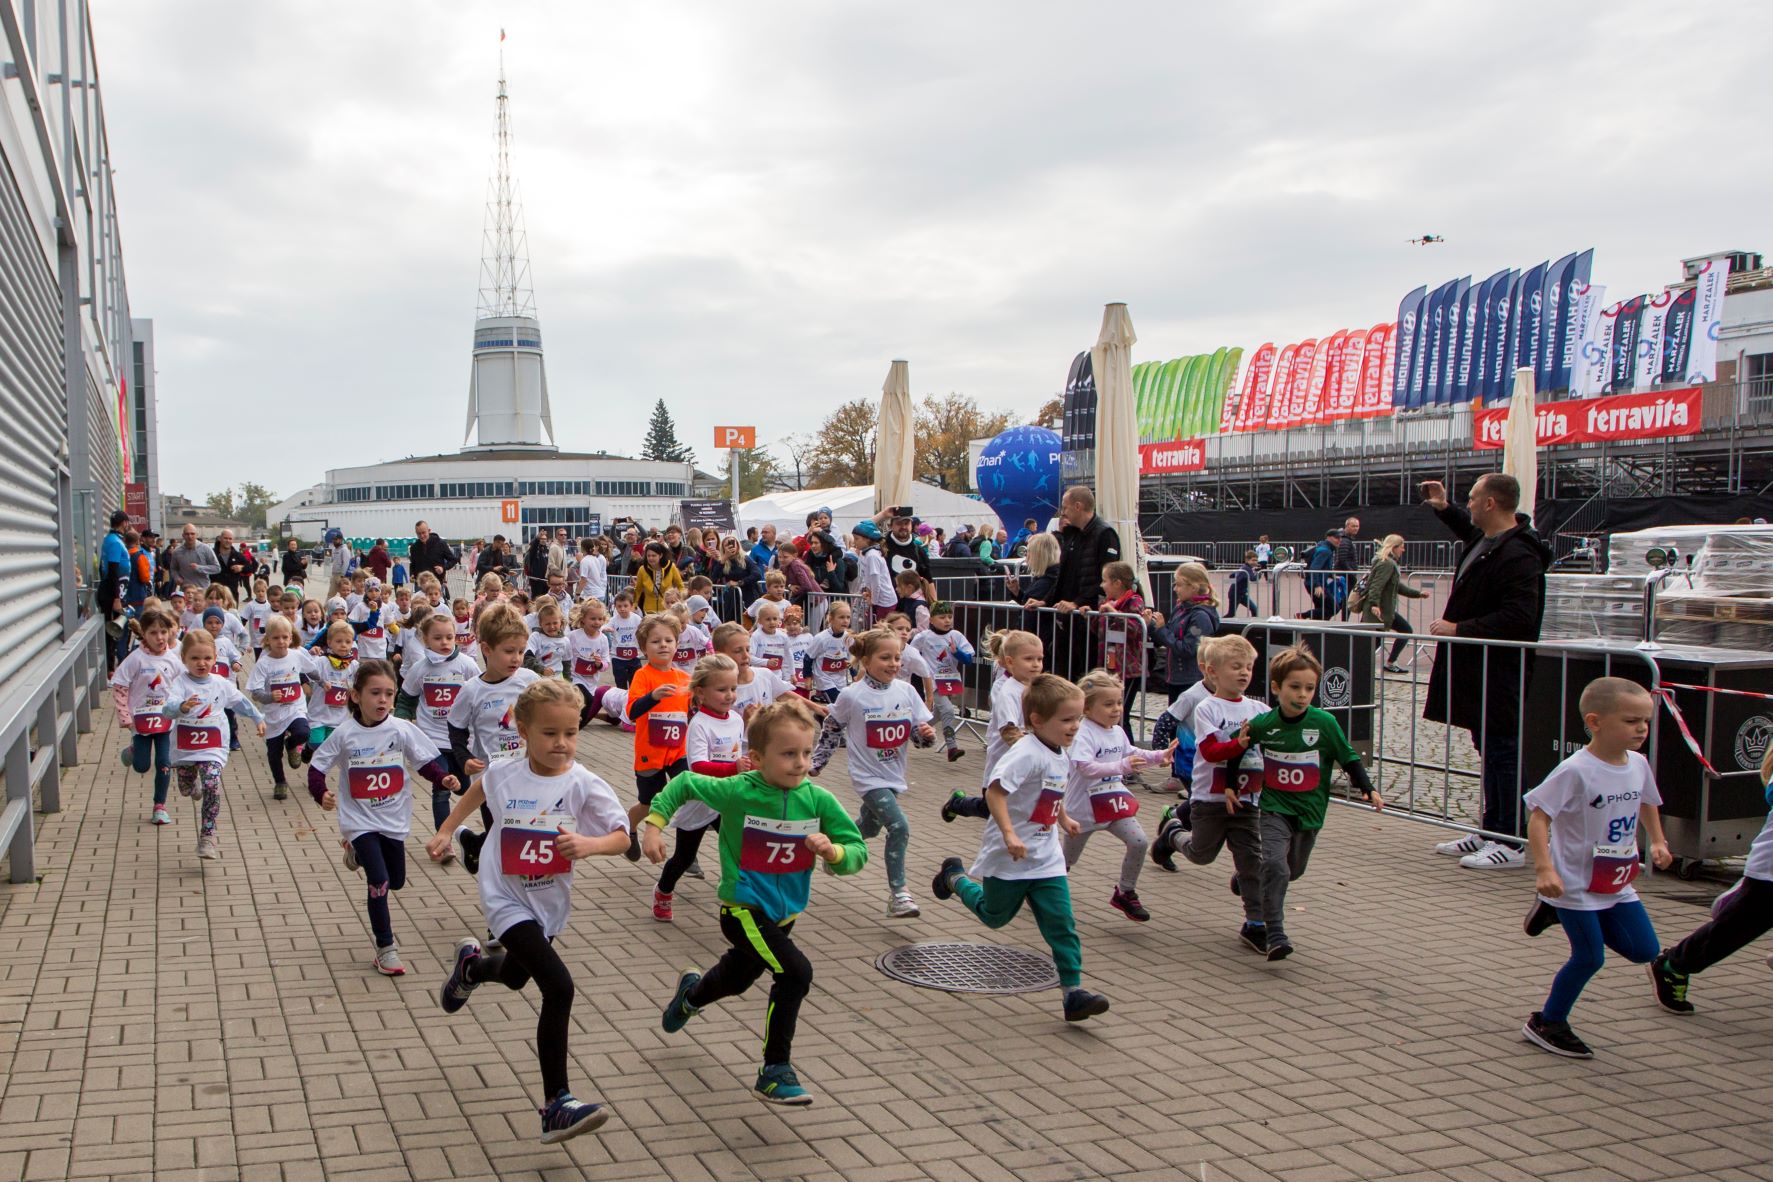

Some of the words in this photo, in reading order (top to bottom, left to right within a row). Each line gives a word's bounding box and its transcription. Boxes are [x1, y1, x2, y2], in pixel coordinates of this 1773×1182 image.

[1562, 306, 1578, 368] HYUNDAI
[1396, 336, 1413, 390] HYUNDAI
[1458, 328, 1474, 386] HYUNDAI
[1336, 337, 1364, 413] terravita
[1588, 398, 1688, 433] terravita
[1482, 410, 1568, 441] terita
[1152, 446, 1200, 468] terravita
[506, 504, 515, 518] 11
[282, 686, 295, 698] 74
[434, 688, 452, 702] 25
[946, 682, 953, 691] 3
[335, 691, 347, 701] 64
[146, 717, 163, 728] 72
[190, 732, 209, 744] 22
[662, 726, 680, 740] 78
[876, 724, 905, 743] 100
[366, 772, 391, 791] 20
[1277, 768, 1304, 785] 80
[506, 800, 516, 809] 21
[1109, 796, 1129, 813] 14
[748, 817, 760, 826] 200
[520, 840, 554, 864] 45
[766, 842, 796, 864] 73
[1612, 864, 1632, 886] 27
